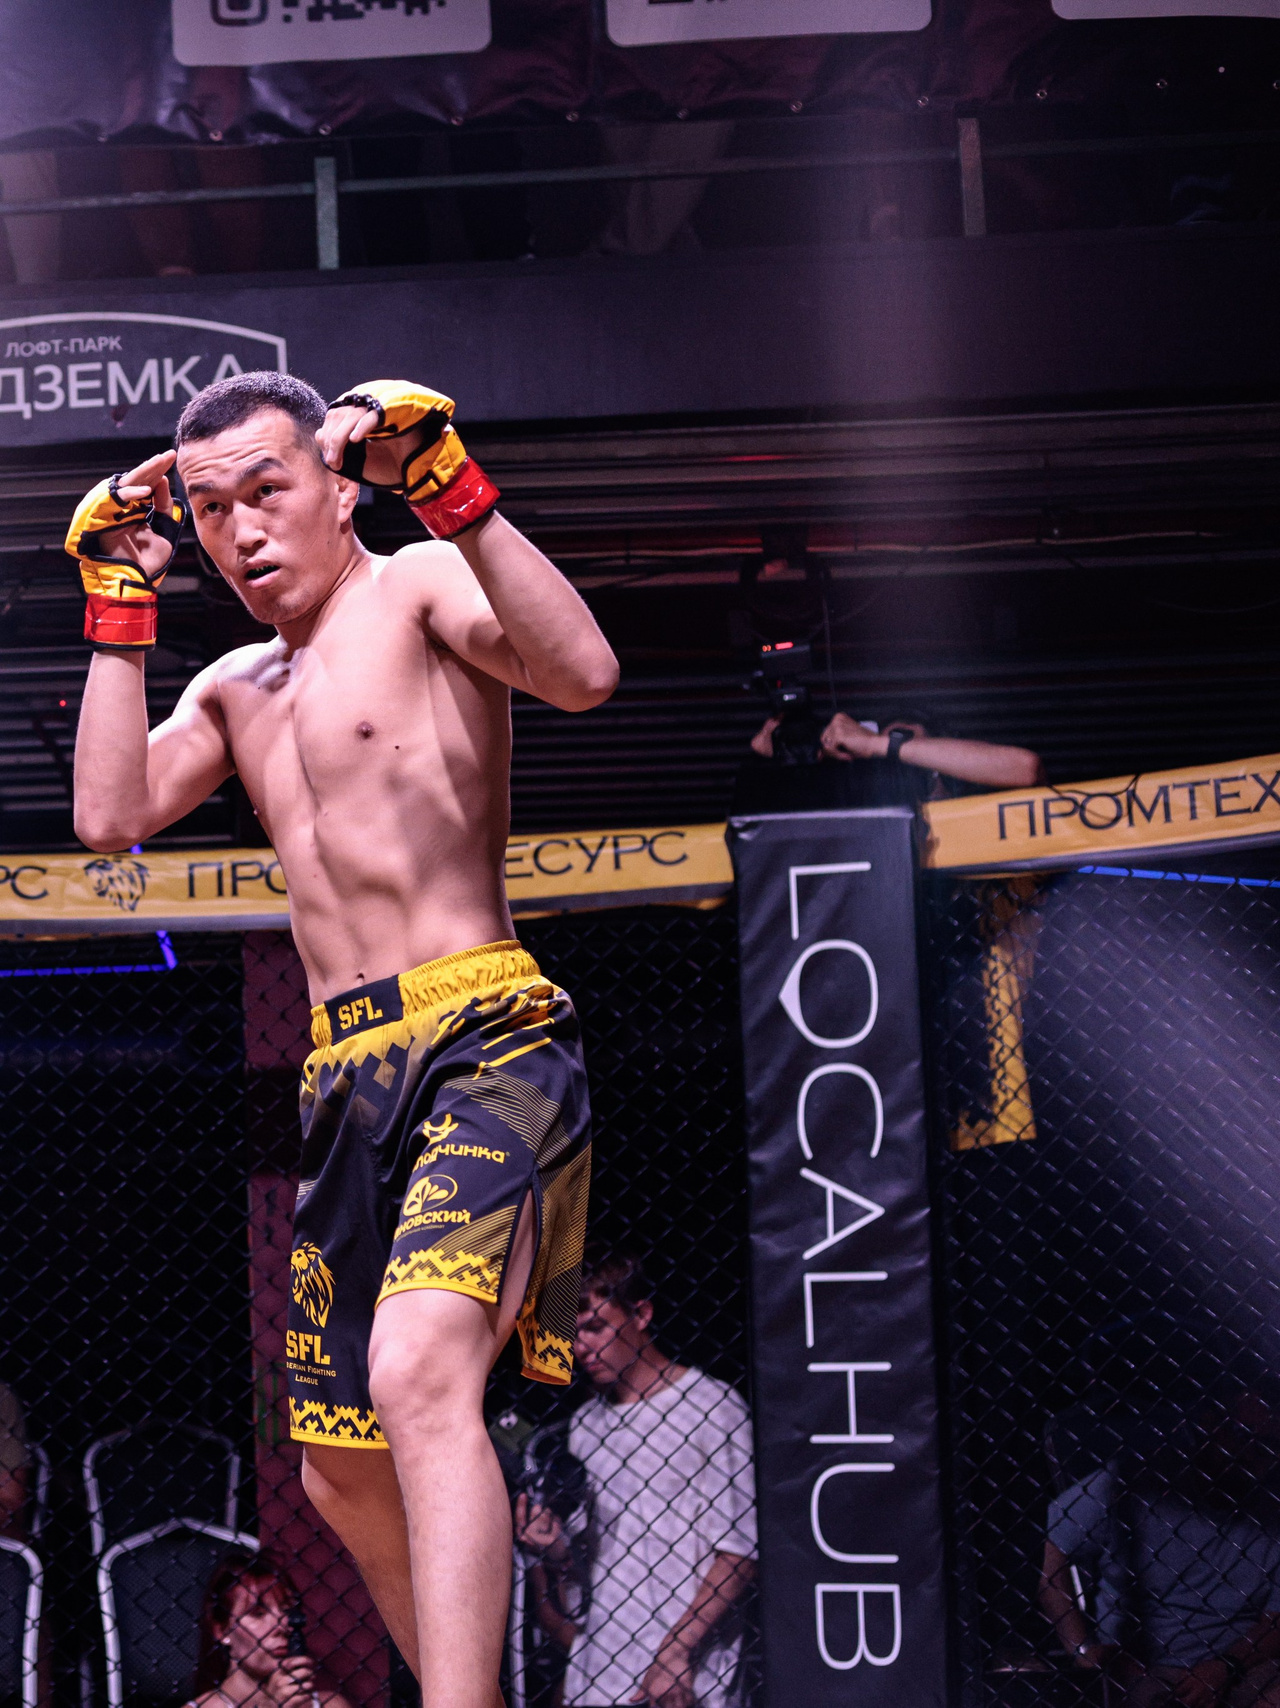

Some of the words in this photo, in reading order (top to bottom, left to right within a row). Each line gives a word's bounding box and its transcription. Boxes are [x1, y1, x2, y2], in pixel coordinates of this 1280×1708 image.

[5, 336, 123, 358] ЛОФТ-ПАРК
[338, 996, 383, 1030] SFL
[412, 1144, 506, 1173] лодчинка
[779, 862, 902, 1670] LOCALHUB
[286, 1329, 331, 1365] SFL
